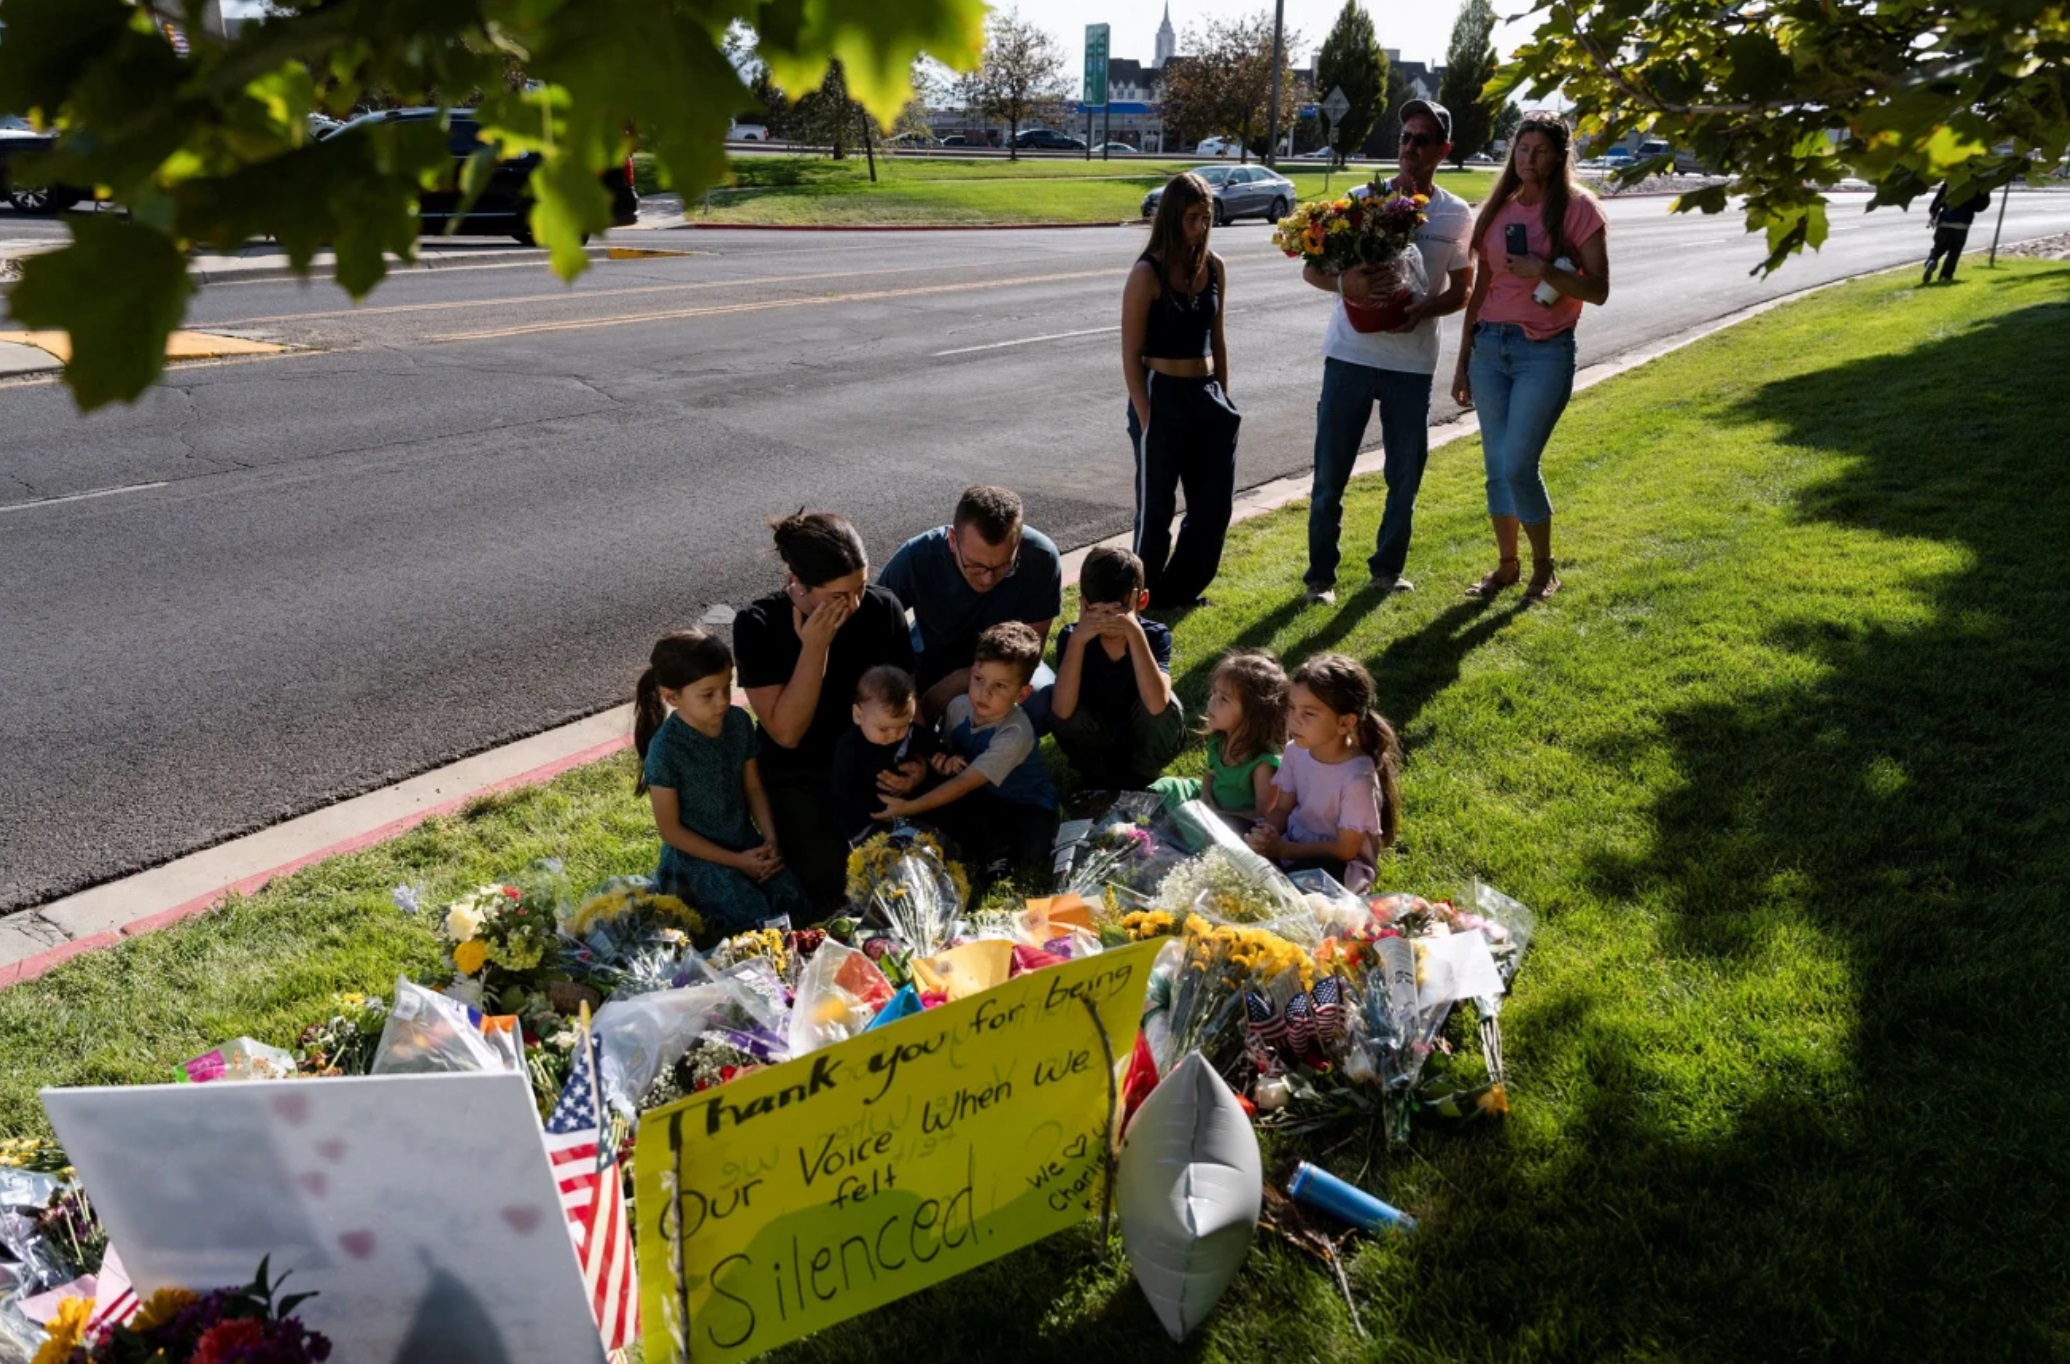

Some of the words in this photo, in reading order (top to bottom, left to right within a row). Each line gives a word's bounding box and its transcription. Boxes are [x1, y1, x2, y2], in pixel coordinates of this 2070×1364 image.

[650, 1055, 843, 1152] Thank
[863, 1033, 945, 1104] you
[969, 999, 1025, 1034] for
[1044, 964, 1133, 1011] being
[659, 1179, 764, 1243] Our
[799, 1132, 893, 1187] Voice
[922, 1082, 1011, 1134] When
[708, 1142, 995, 1348] Silenced.
[830, 1163, 897, 1210] felt
